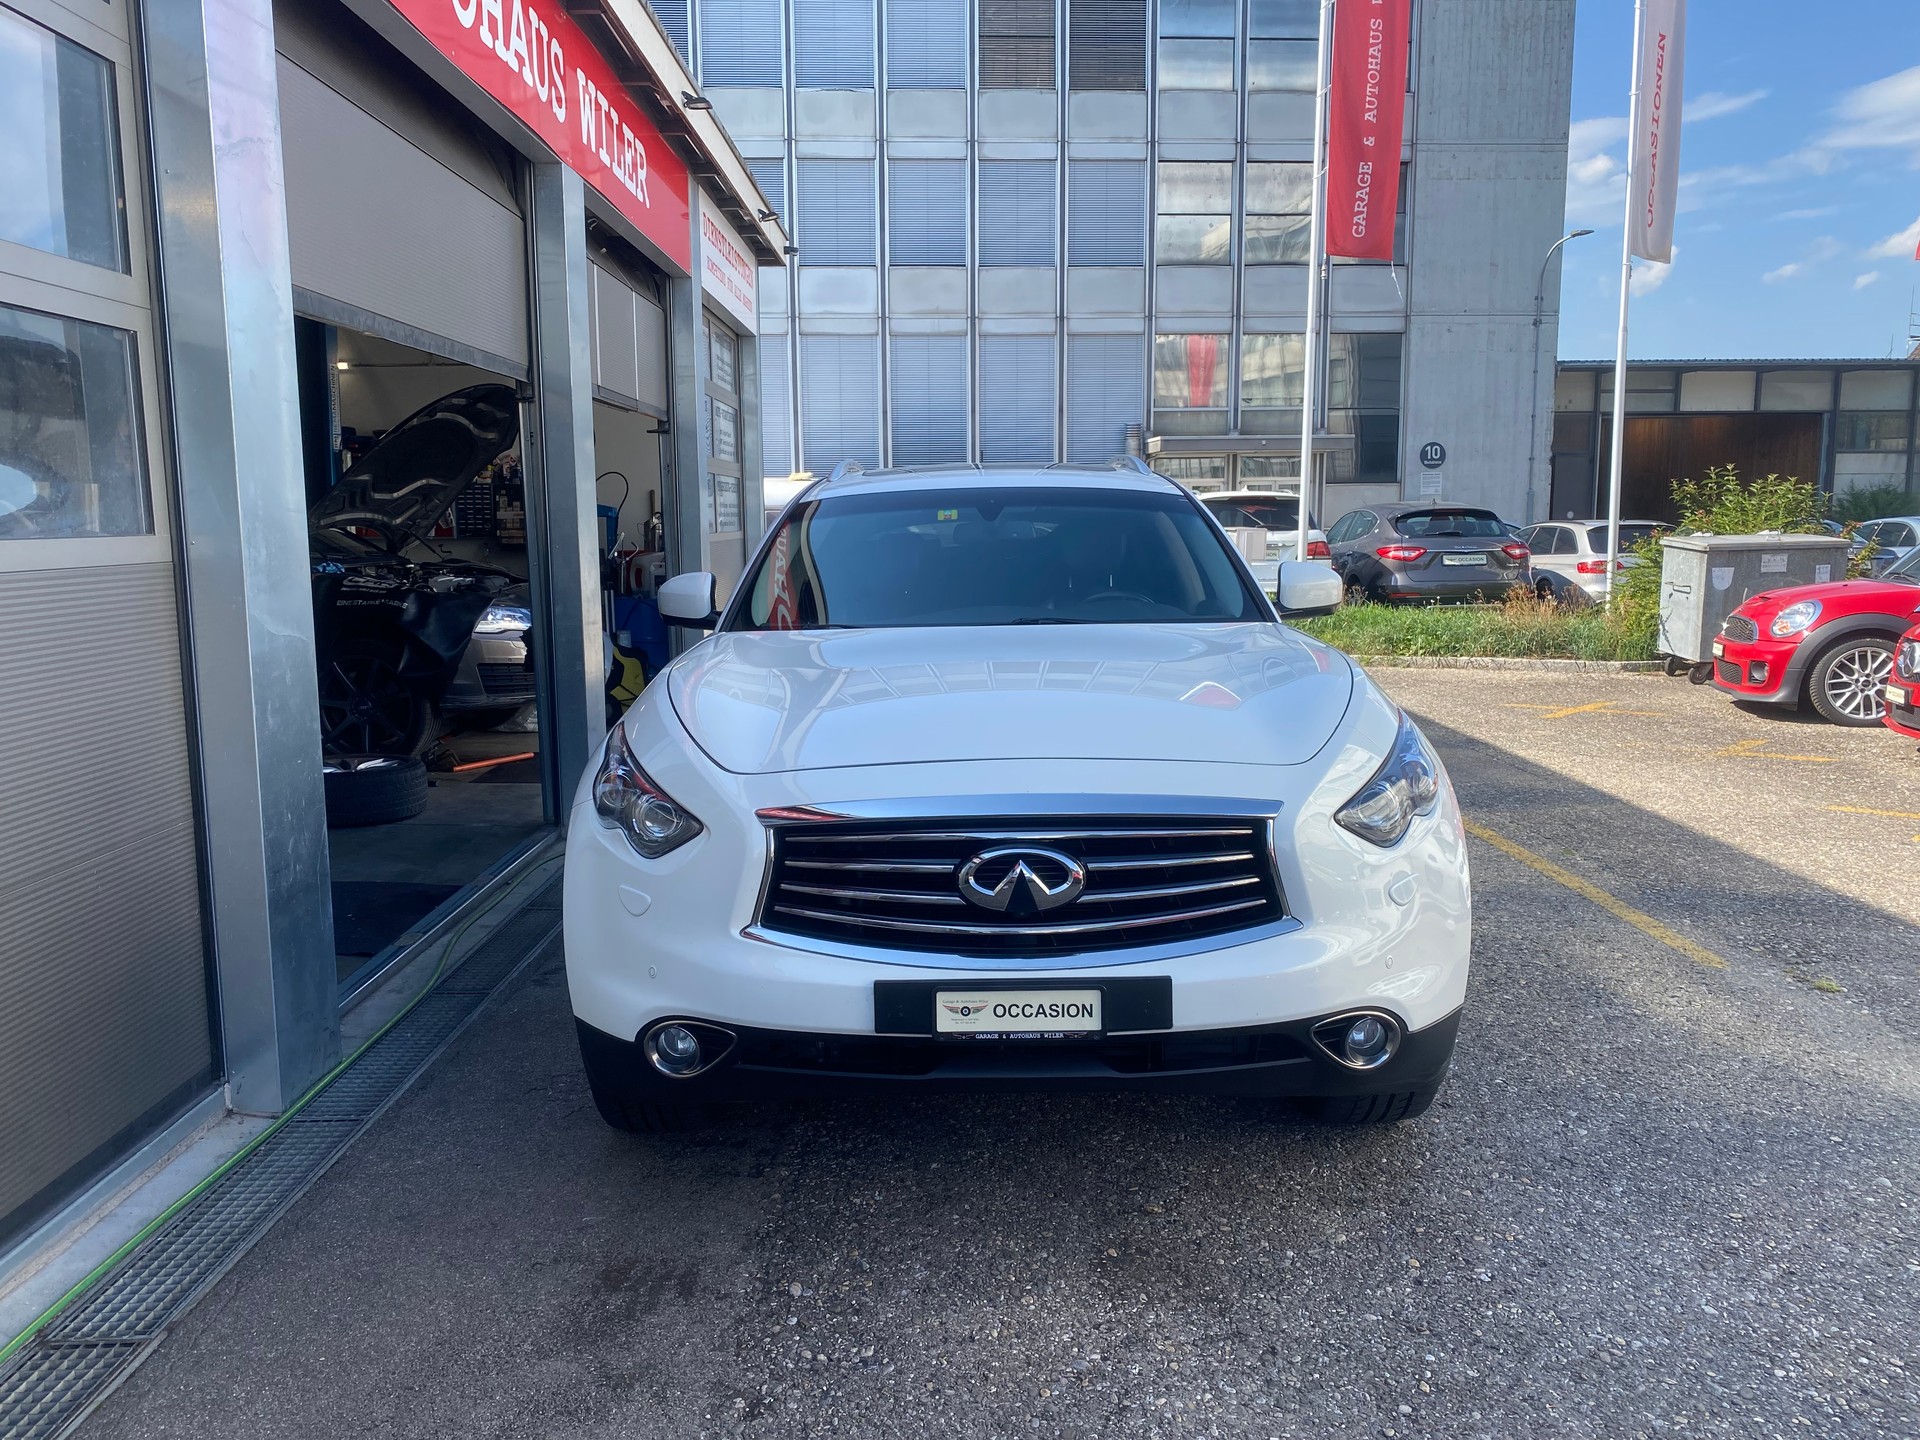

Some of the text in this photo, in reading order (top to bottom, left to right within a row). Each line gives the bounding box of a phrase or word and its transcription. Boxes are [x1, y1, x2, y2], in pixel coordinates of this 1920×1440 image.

[452, 0, 650, 209] HAUS WILER
[1364, 18, 1383, 124] AUTOHAUS
[1363, 136, 1375, 146] &
[1647, 32, 1667, 228] OCCASIONEN
[1352, 161, 1373, 238] GARAGE
[1425, 445, 1441, 459] 10
[993, 1003, 1094, 1019] OCCASION
